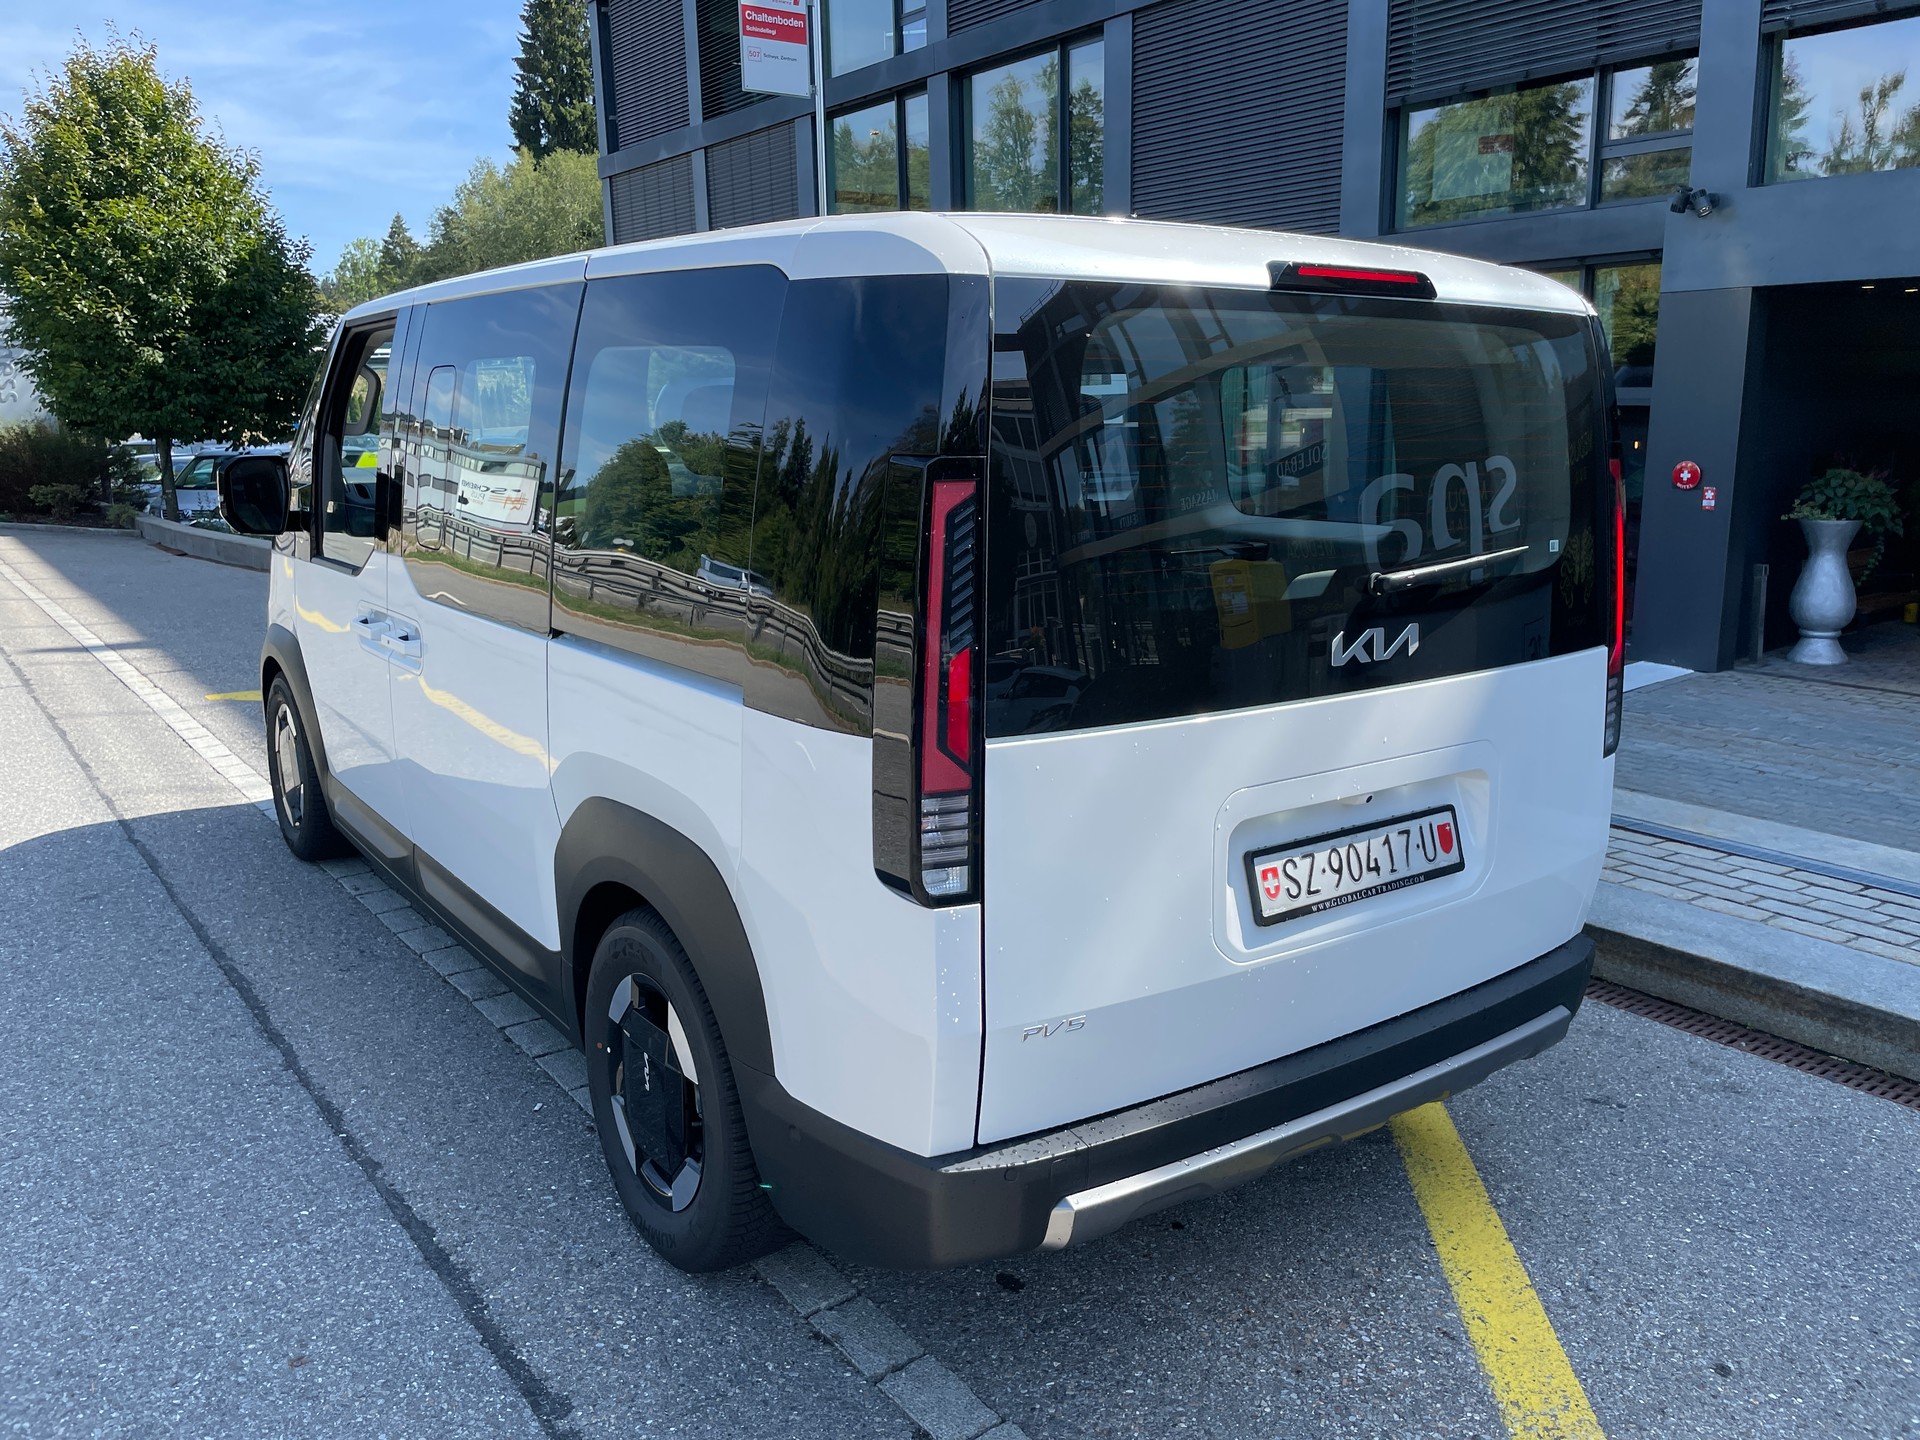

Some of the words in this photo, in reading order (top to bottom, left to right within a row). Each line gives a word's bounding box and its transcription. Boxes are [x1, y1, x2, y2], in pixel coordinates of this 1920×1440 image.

[745, 10, 804, 28] Chaltenboden
[1331, 623, 1420, 667] KIA
[1021, 1014, 1087, 1042] PV5
